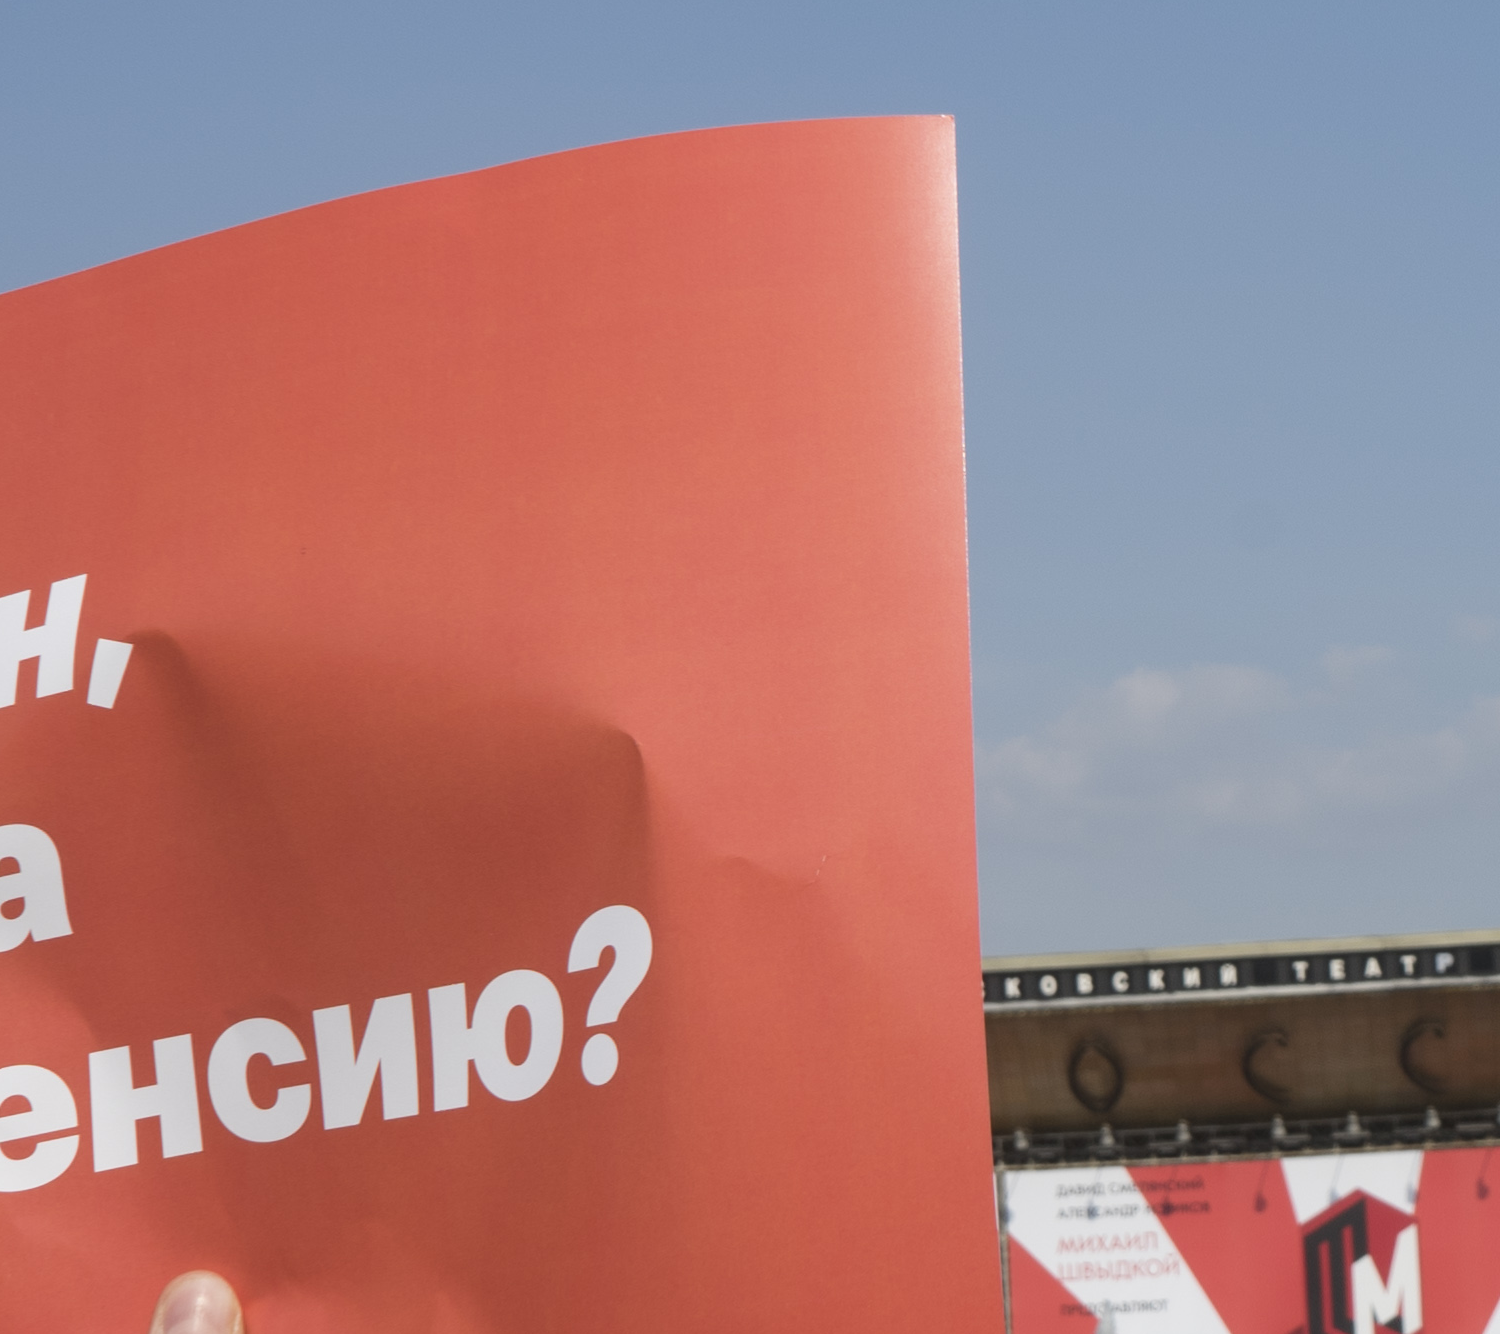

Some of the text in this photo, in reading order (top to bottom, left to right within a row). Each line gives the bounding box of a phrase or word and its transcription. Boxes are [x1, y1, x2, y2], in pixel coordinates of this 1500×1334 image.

[982, 963, 1238, 1002] КОВСКИЙ
[1292, 953, 1455, 983] ТЕАТР
[1055, 1230, 1160, 1255] МИХАИЛ
[1058, 1252, 1181, 1281] ШВЫДКОЙ
